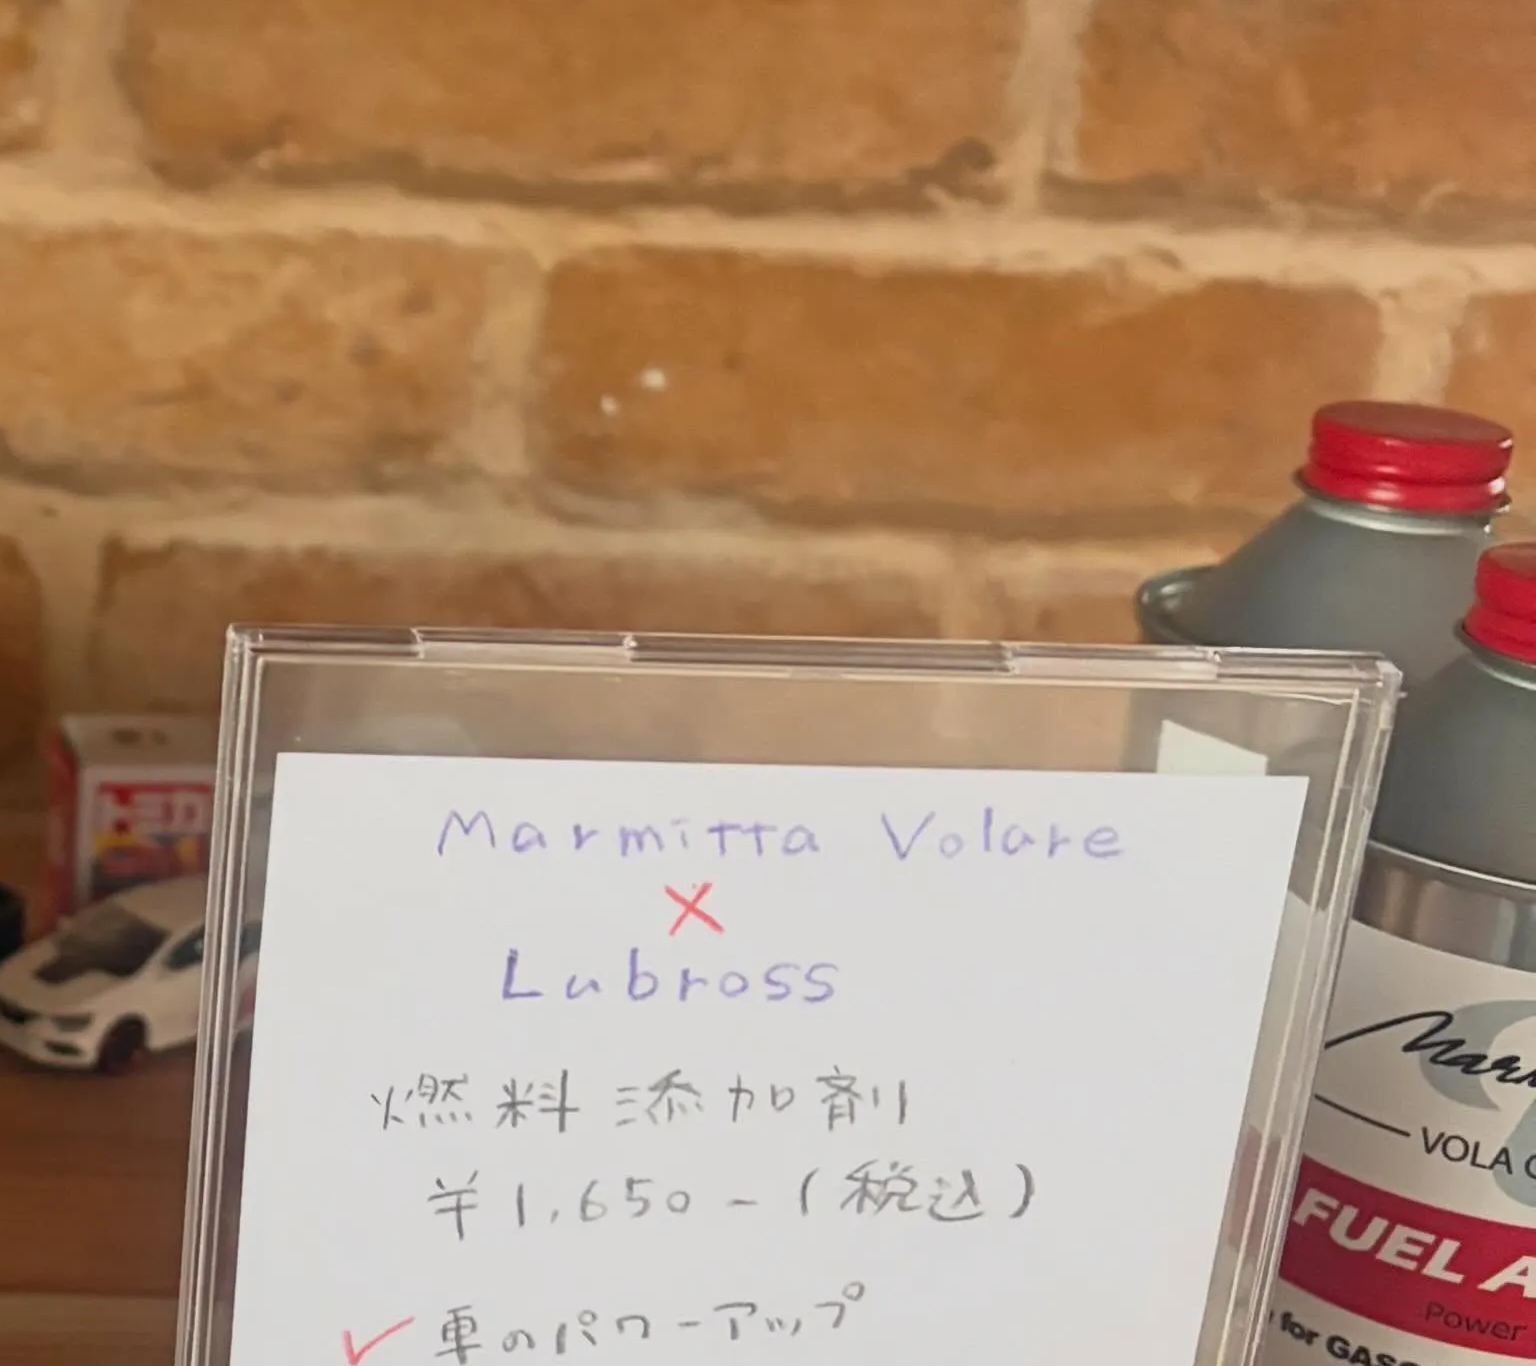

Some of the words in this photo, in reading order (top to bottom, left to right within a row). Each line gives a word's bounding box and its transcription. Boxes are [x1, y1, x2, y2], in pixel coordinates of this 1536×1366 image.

[435, 808, 821, 860] Marmitta
[880, 806, 1127, 861] Volare
[501, 947, 840, 1004] Lubross
[369, 1065, 909, 1134] 燃料添加剤
[1421, 1126, 1513, 1175] VOLA
[1292, 1187, 1465, 1285] FUEL
[434, 1281, 866, 1366] 車のパワーアップ
[1280, 1311, 1320, 1346] for
[1424, 1301, 1527, 1342] Power
